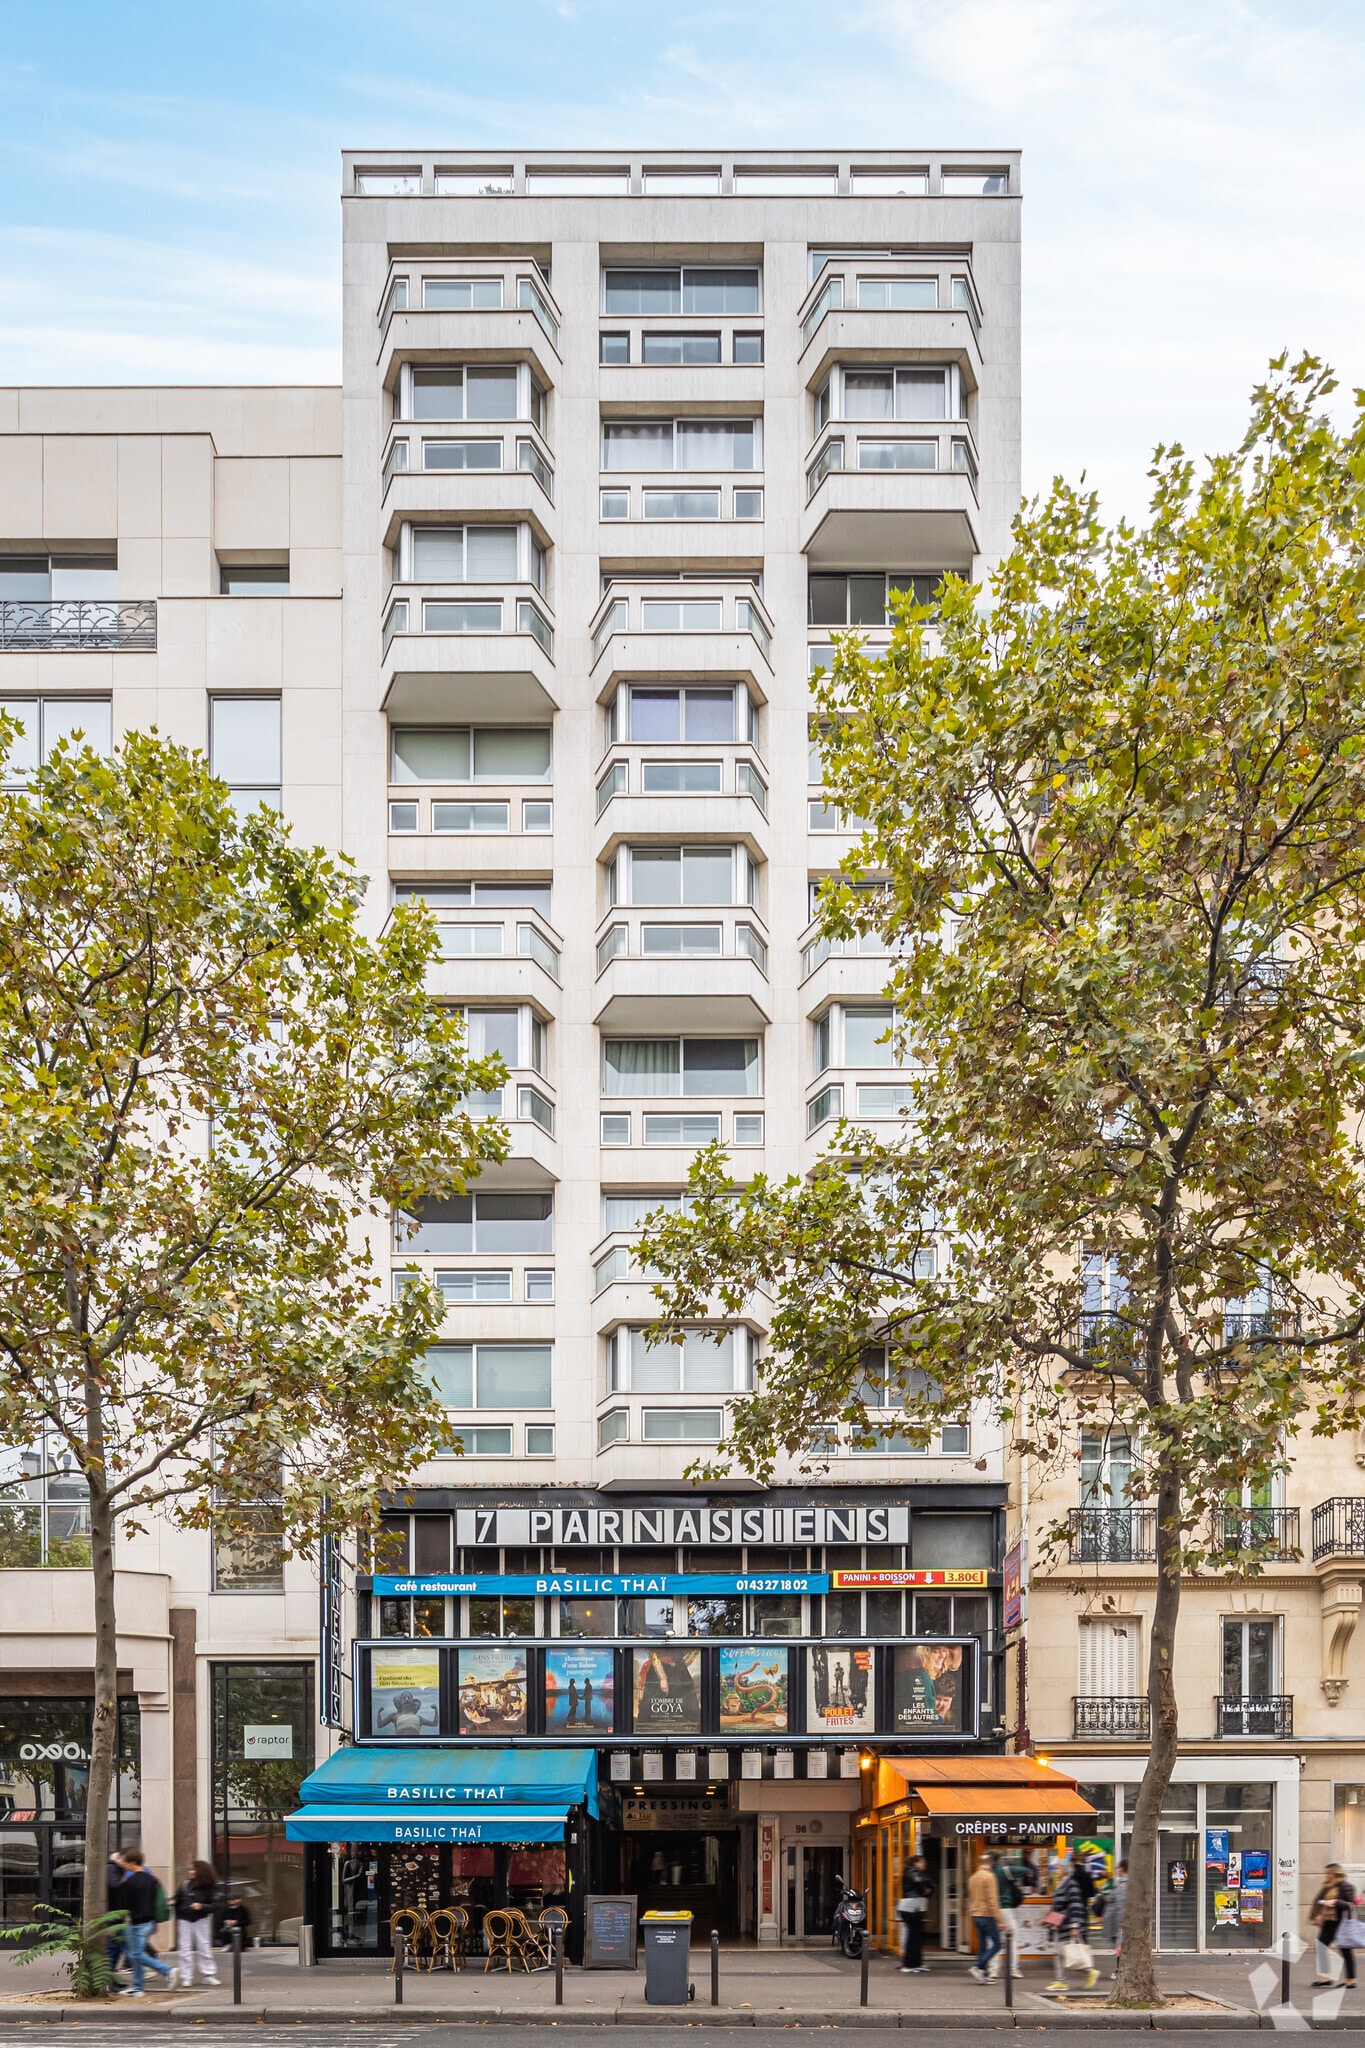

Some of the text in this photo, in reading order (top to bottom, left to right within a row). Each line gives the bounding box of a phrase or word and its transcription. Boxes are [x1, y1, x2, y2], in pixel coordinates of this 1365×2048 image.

[477, 1509, 888, 1543] 7 PARNASSIENS
[843, 1573, 870, 1582] PANINI
[879, 1573, 915, 1581] BOISSON
[948, 1572, 979, 1582] 3.80€
[394, 1580, 477, 1592] café restaurant
[536, 1576, 667, 1592] BASILIC THAÏ
[564, 1656, 594, 1664] chronique
[651, 1703, 683, 1713] GOYA
[825, 1707, 854, 1717] POULET
[826, 1717, 854, 1727] FRITES
[257, 1736, 289, 1745] raptor
[388, 1786, 505, 1799] BASILIC THAÏ
[627, 1801, 712, 1810] PRESSING
[395, 1825, 481, 1838] BASILIC THAÏ
[795, 1825, 807, 1833] 98
[955, 1820, 1007, 1834] CRÊPES
[1019, 1822, 1074, 1834] PANINIS
